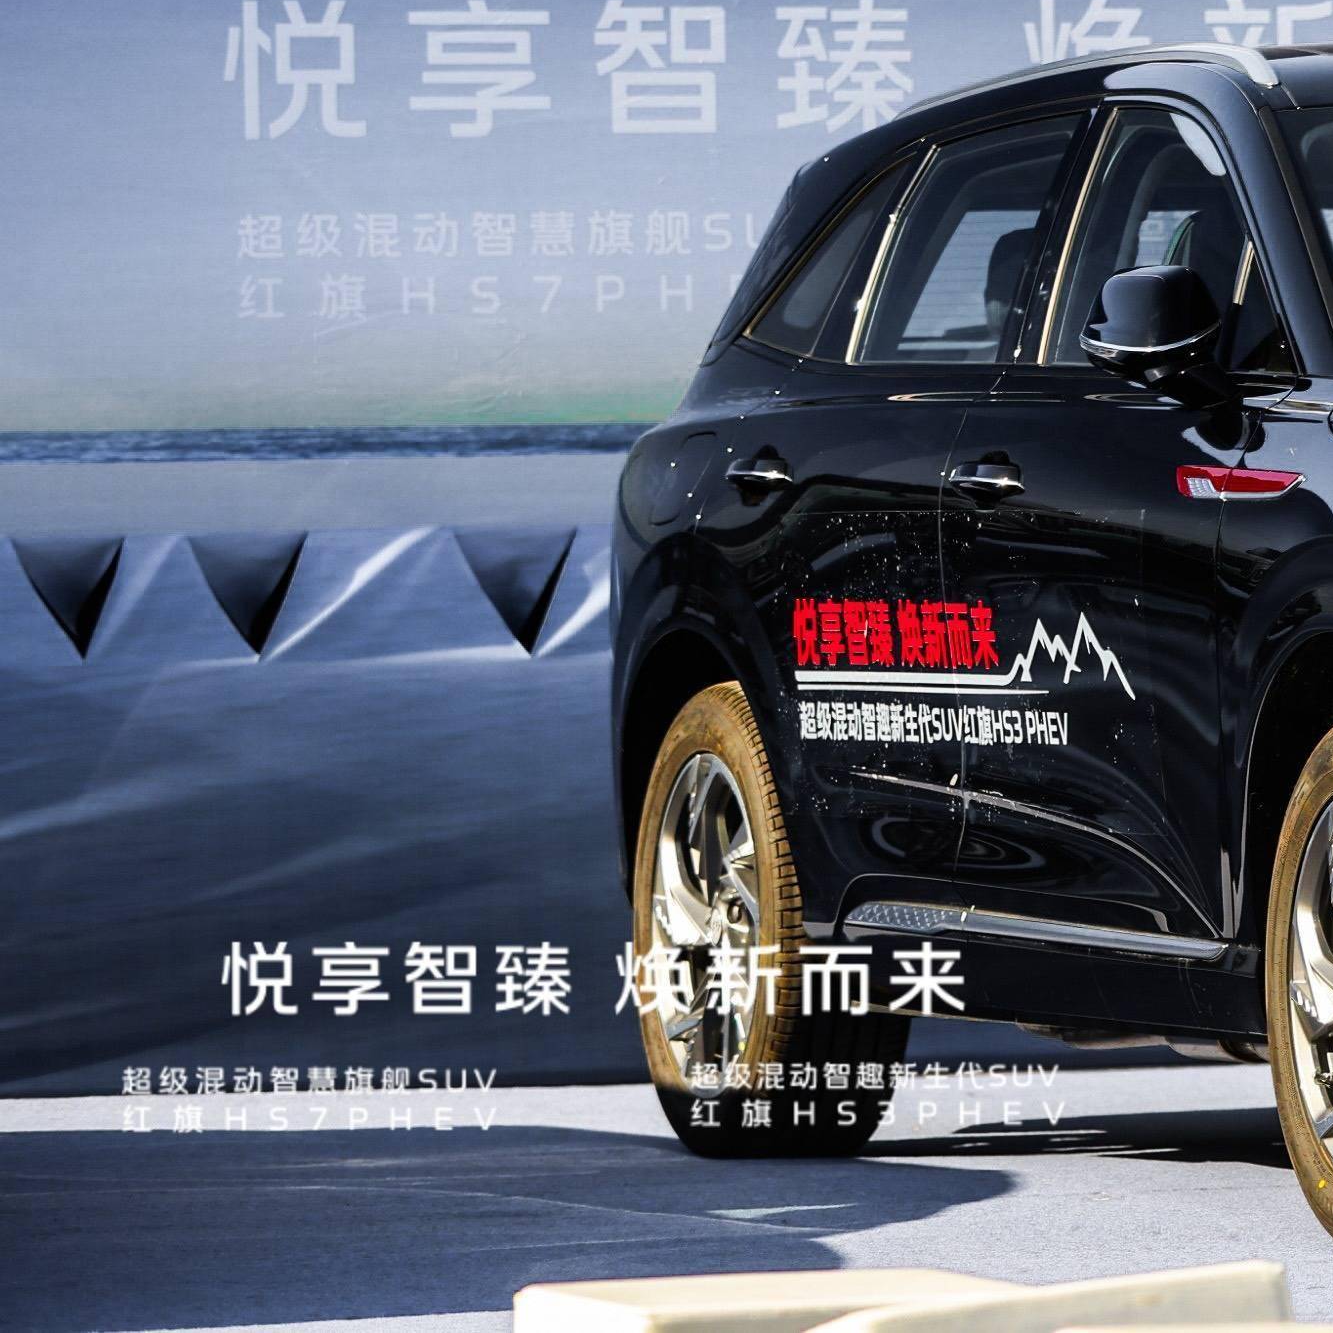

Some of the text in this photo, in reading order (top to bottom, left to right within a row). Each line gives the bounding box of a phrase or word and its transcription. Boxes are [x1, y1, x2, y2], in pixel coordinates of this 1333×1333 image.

[793, 598, 999, 669] 悦享智臻 焕新而来
[1026, 712, 1069, 746] PHEV
